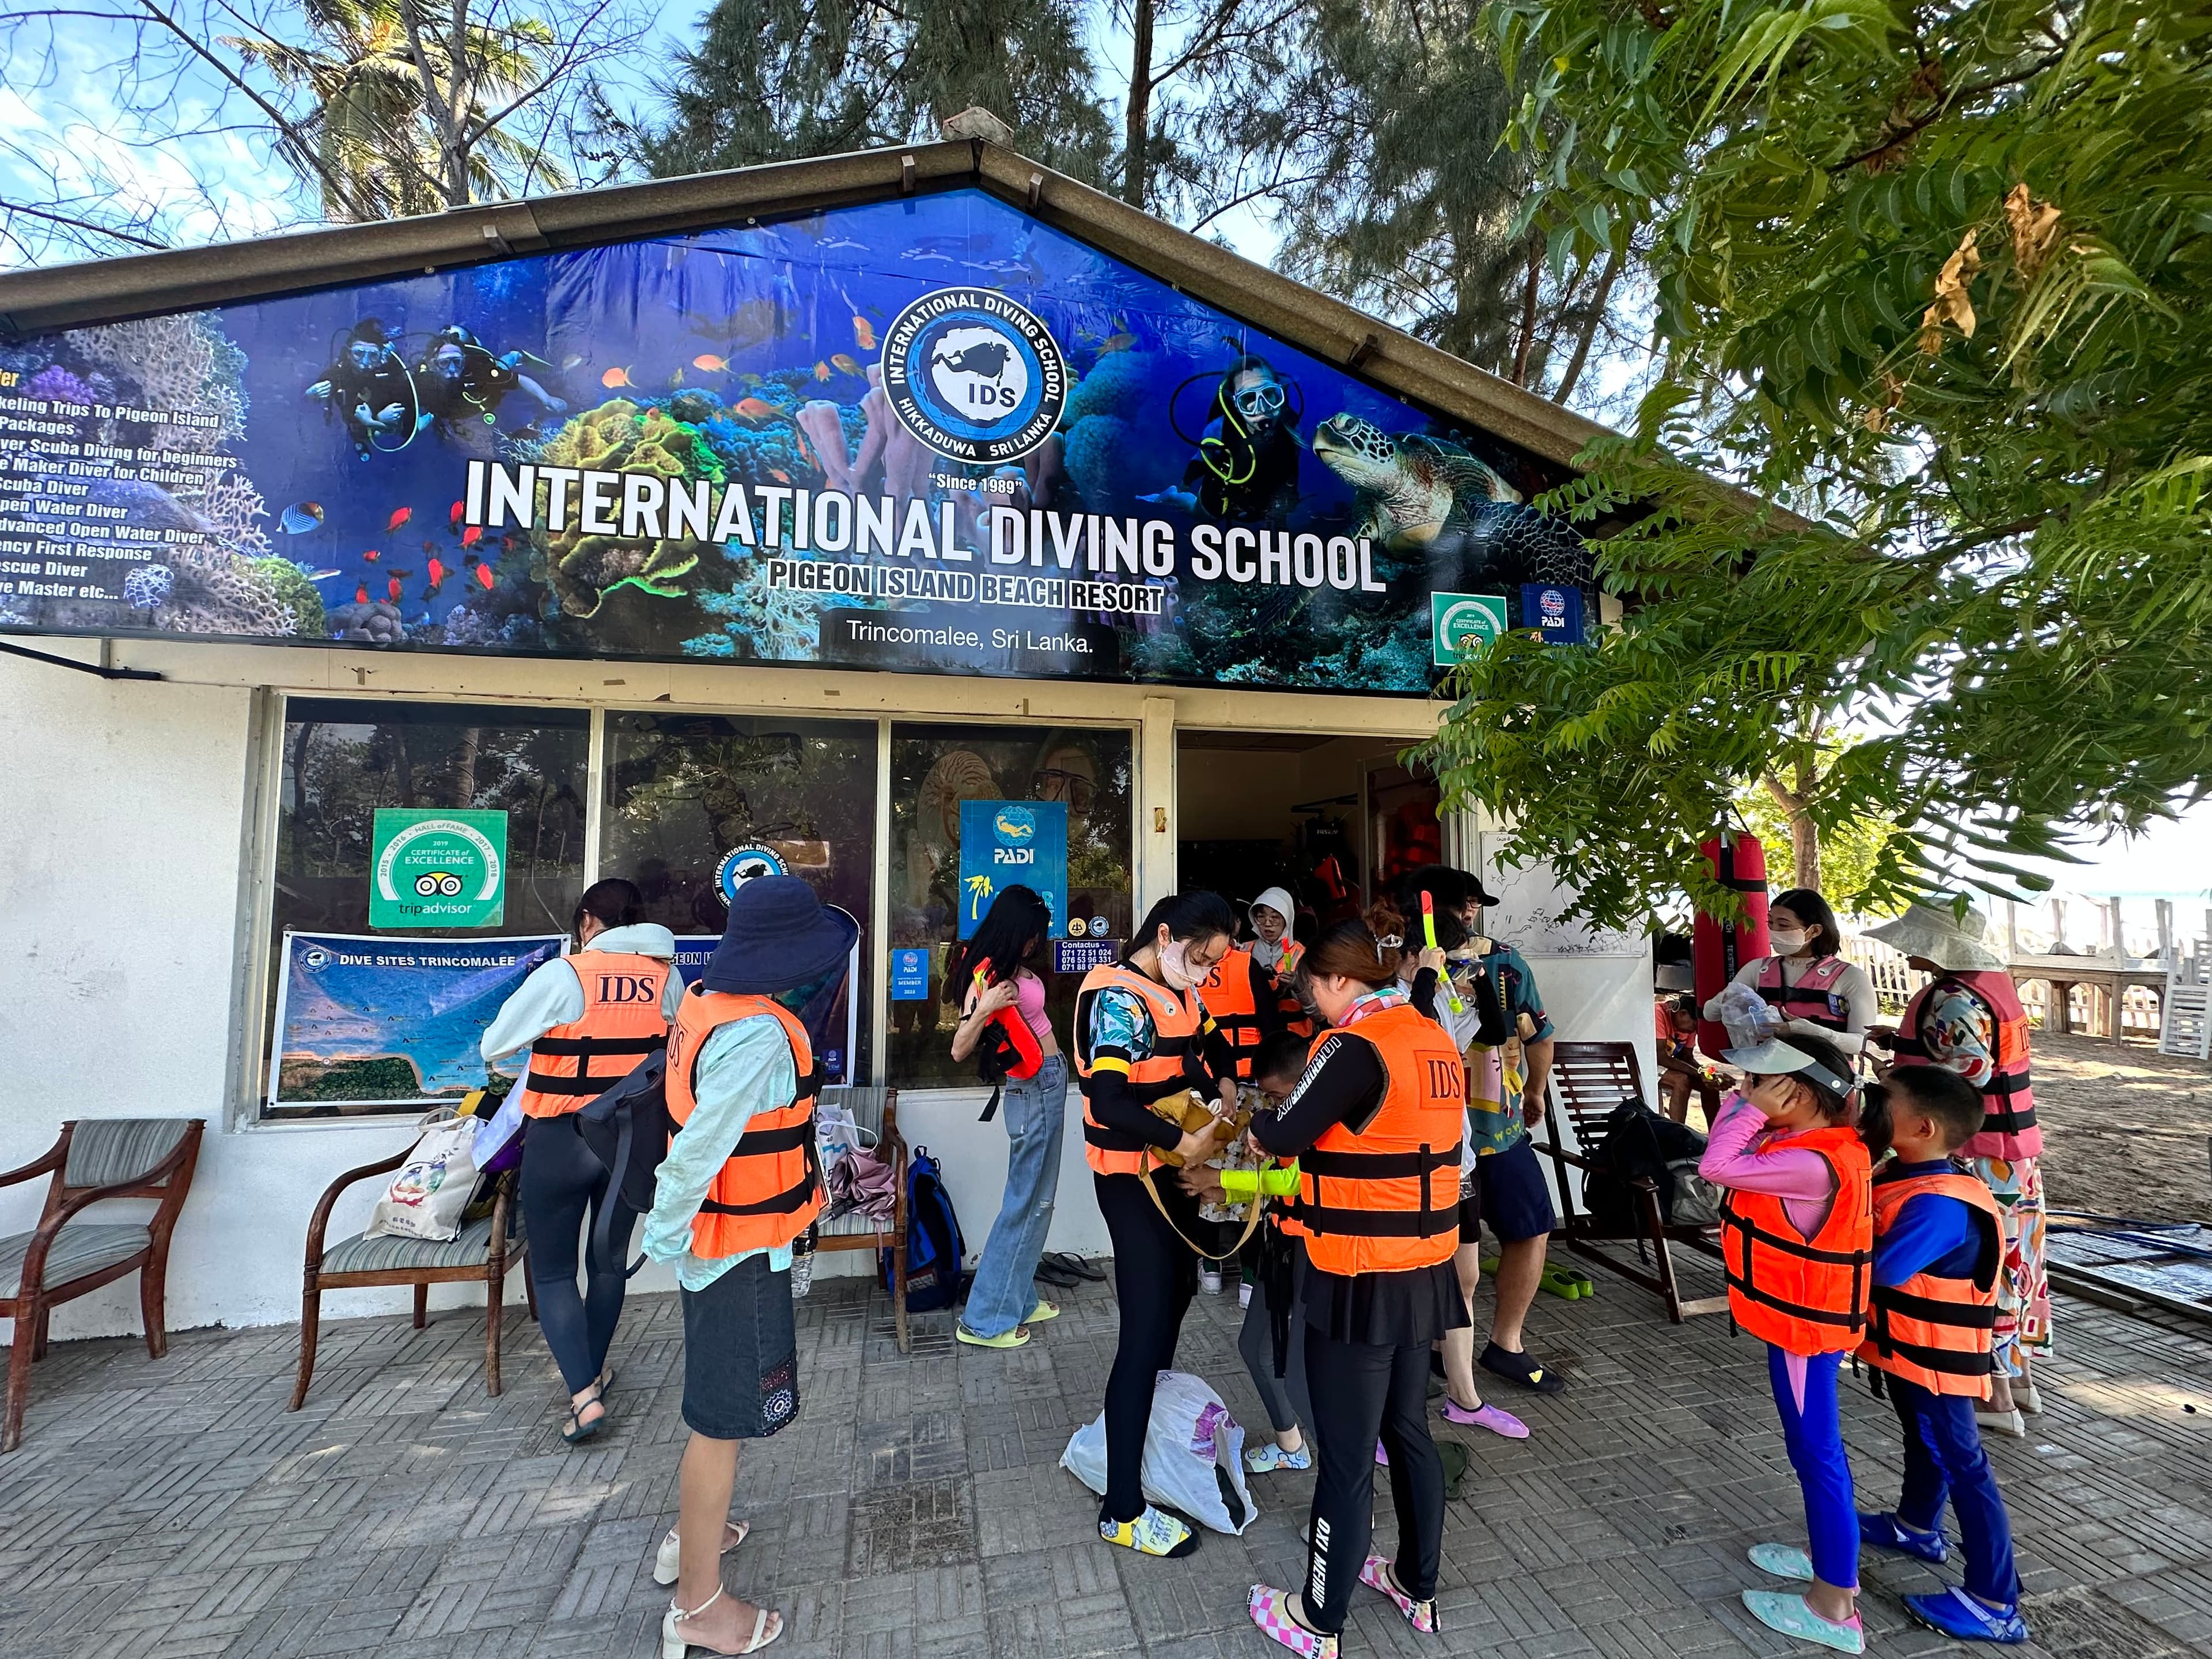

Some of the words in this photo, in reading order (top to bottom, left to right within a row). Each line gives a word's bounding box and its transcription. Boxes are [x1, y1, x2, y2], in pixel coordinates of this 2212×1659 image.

[889, 294, 979, 385] INTERNATIONAL
[984, 297, 1039, 338] DIVING
[1034, 338, 1060, 403] SCHOOL
[0, 368, 19, 387] er
[969, 384, 1016, 407] IDS
[0, 416, 75, 435] Packages
[52, 400, 90, 417] Trips
[94, 404, 111, 418] To
[115, 406, 168, 423] Pigeon
[173, 411, 219, 428] Island
[899, 397, 976, 457] HIKKADUWA
[989, 441, 1015, 457] SRI
[1014, 412, 1052, 449] LANKA
[30, 438, 79, 456] Scuba
[84, 443, 132, 461] Diving
[137, 448, 159, 461] for
[162, 449, 237, 468] beginners
[13, 458, 65, 474] Maker
[69, 461, 110, 478] Diver
[114, 464, 136, 479] for
[139, 467, 204, 485] Children
[46, 480, 89, 496] Diver
[35, 499, 83, 516] Water
[86, 503, 128, 519] Diver
[70, 522, 110, 539] Open
[115, 525, 161, 541] Water
[165, 529, 205, 544] Diver
[464, 460, 972, 562] INTERNATIONAL
[991, 505, 1175, 576] DIVING
[1191, 524, 1387, 592] SCHOOL
[0, 541, 32, 555] ncy
[36, 540, 72, 556] First
[76, 543, 152, 561] Response
[0, 561, 41, 575] scue
[45, 561, 88, 577] Diver
[18, 580, 75, 597] Master
[79, 585, 119, 600] etc...
[768, 560, 874, 594] PIGEON
[878, 565, 976, 603] ISLAND
[979, 573, 1064, 608] BEACH
[1070, 578, 1164, 615] RESORT
[1541, 616, 1565, 628] PADI
[846, 619, 984, 650] Trincomalee,
[991, 628, 1020, 649] Sri
[1027, 630, 1093, 654] Lanka.
[381, 859, 389, 877] 2015
[391, 836, 407, 851] 2016
[415, 823, 436, 833] HALL
[446, 823, 468, 834] FAME
[474, 836, 490, 853] 2017
[405, 856, 475, 865] EXCELLENCE
[994, 848, 1034, 864] PADI
[715, 843, 754, 888] INTERNATIONAL
[756, 844, 780, 859] DIVING
[777, 858, 789, 876] SCH
[399, 902, 472, 916] tripadvisor
[339, 954, 373, 966] DIVE
[376, 956, 416, 967] SITES
[418, 956, 516, 967] TRINCOMALEE
[1727, 944, 1735, 980] TEXSTRETC
[598, 976, 654, 1003] IDS
[1427, 1060, 1460, 1099] IDS
[1150, 1512, 1166, 1546] PATTE
[1162, 1516, 1175, 1543] DESIG
[1315, 1517, 1331, 1552] OXI
